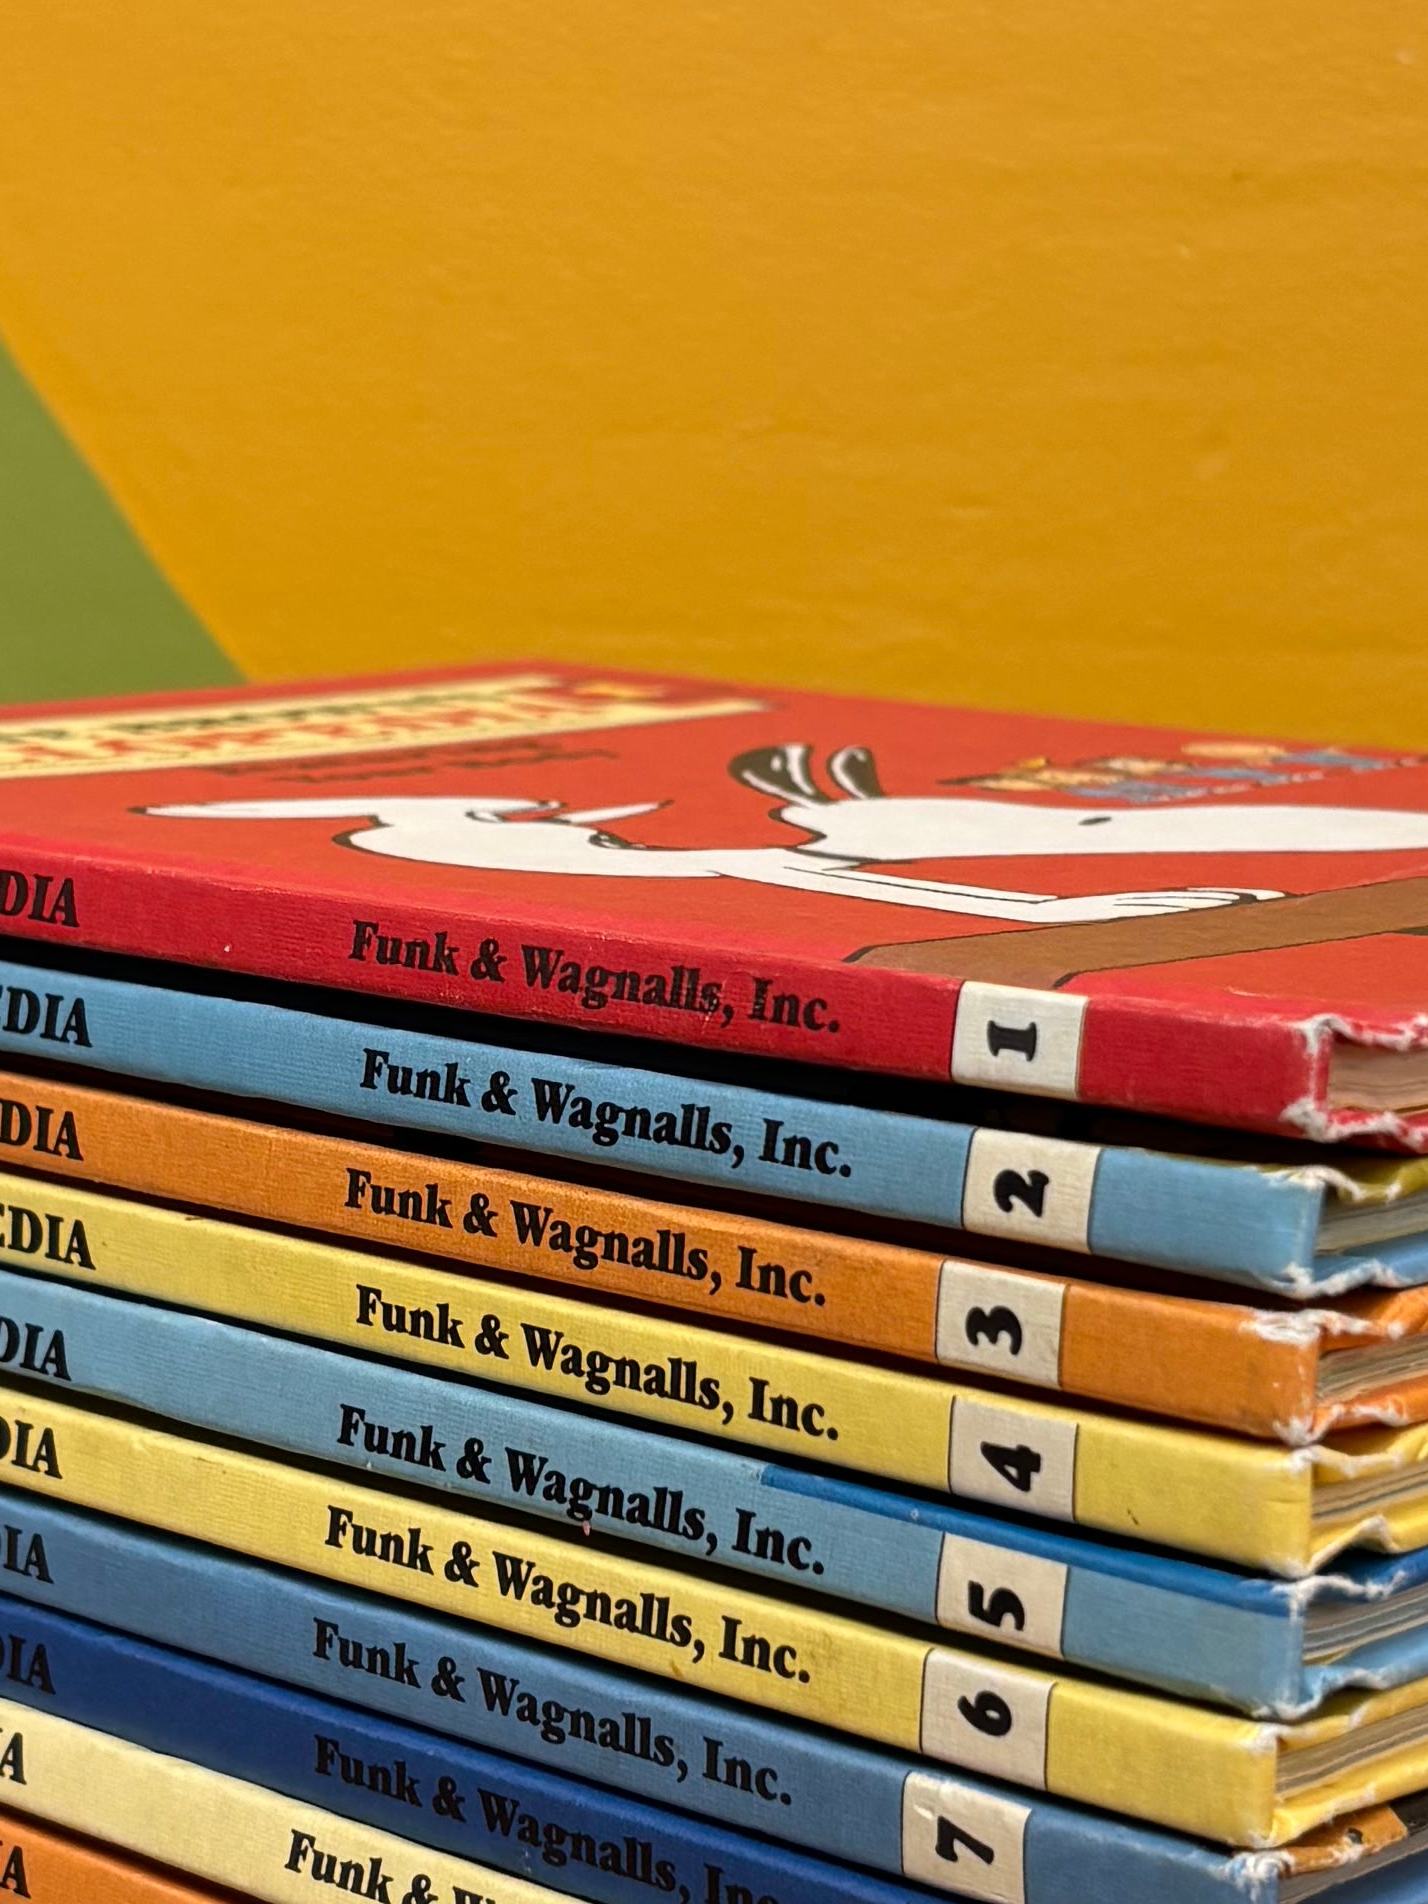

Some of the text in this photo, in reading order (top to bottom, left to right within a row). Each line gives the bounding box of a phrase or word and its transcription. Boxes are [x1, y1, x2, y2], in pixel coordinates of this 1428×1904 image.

[349, 920, 839, 1033] Funk & Wagnalls, Inc.
[987, 1020, 1038, 1062] 1
[359, 1047, 852, 1178] Funk & Wagnalls, Inc.
[344, 1167, 826, 1307] Funk & Wagnalls, Inc.
[993, 1169, 1050, 1218] 2
[356, 1284, 839, 1441] Funk & Wagnalls, Inc.
[965, 1305, 1023, 1356] 3
[336, 1403, 825, 1576] Funk & Wagnalls, Inc.
[980, 1441, 1042, 1493] 4
[324, 1505, 810, 1684] Funk & Wagnalls, Inc.
[967, 1580, 1026, 1632] 5
[312, 1617, 792, 1806] Funk & Wagnalls, Inc.
[957, 1690, 1013, 1738] 6
[314, 1734, 422, 1808] Funk
[432, 1776, 466, 1823] &
[935, 1816, 995, 1865] 7
